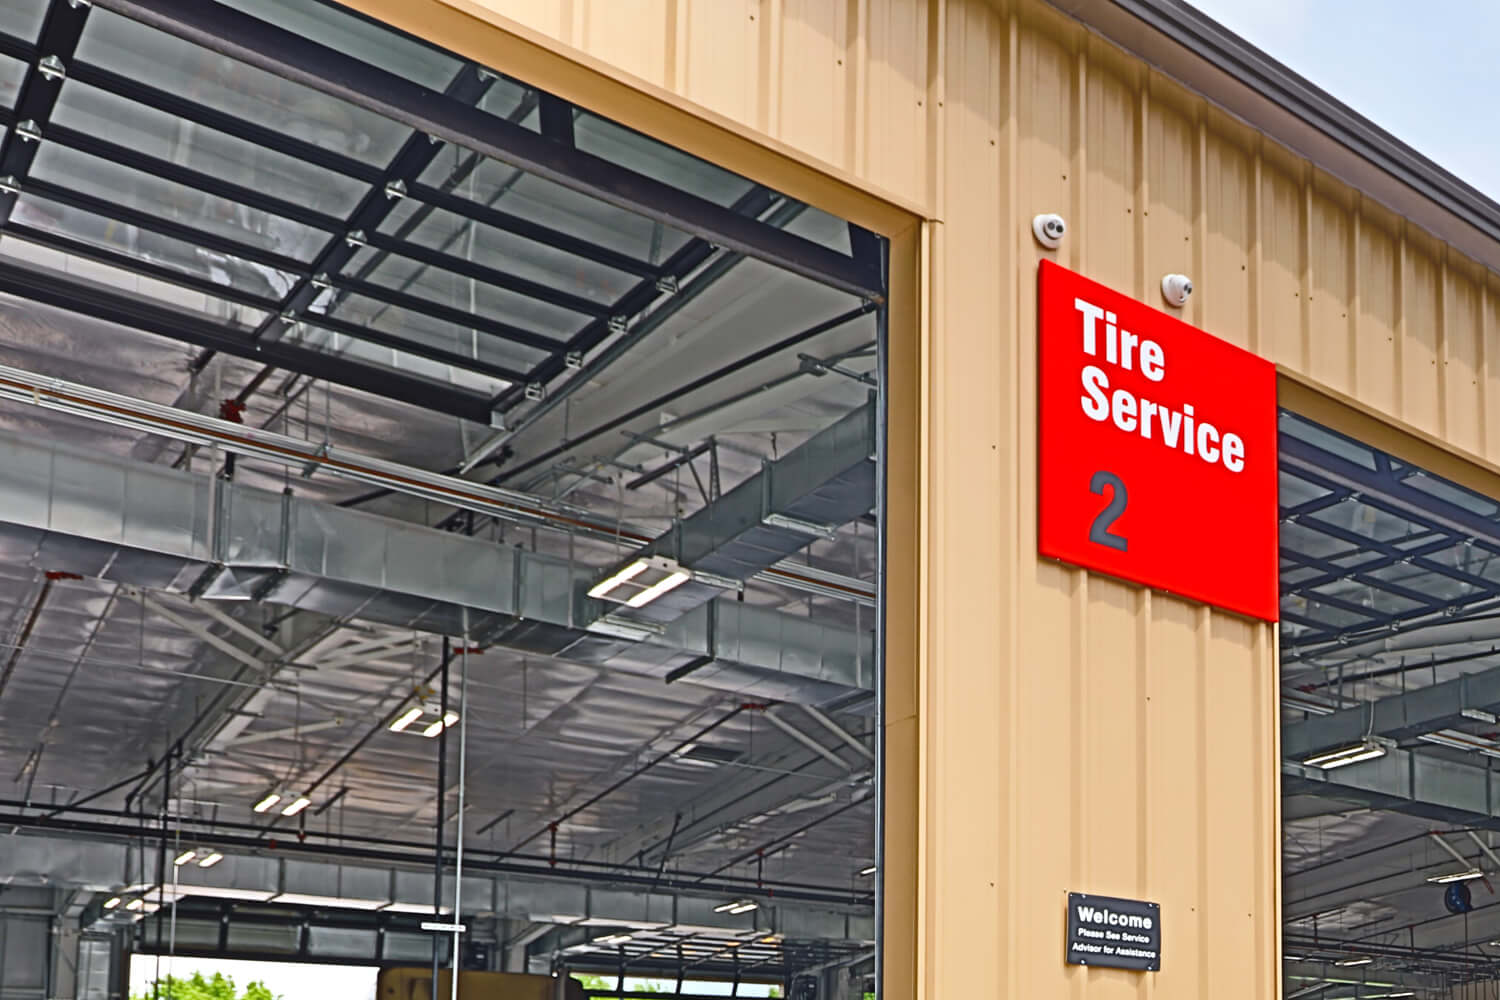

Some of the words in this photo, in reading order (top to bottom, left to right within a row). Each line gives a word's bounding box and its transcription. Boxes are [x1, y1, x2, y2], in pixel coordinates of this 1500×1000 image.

[1074, 297, 1165, 382] Tire
[1080, 365, 1245, 473] Service
[1088, 470, 1128, 553] 2
[1077, 905, 1152, 930] Welcome
[1077, 927, 1104, 939] Please
[1105, 930, 1121, 940] See
[1121, 932, 1150, 943] Service
[1072, 942, 1102, 953] Advisor
[1103, 945, 1114, 954] for
[1115, 947, 1156, 958] Assistance
